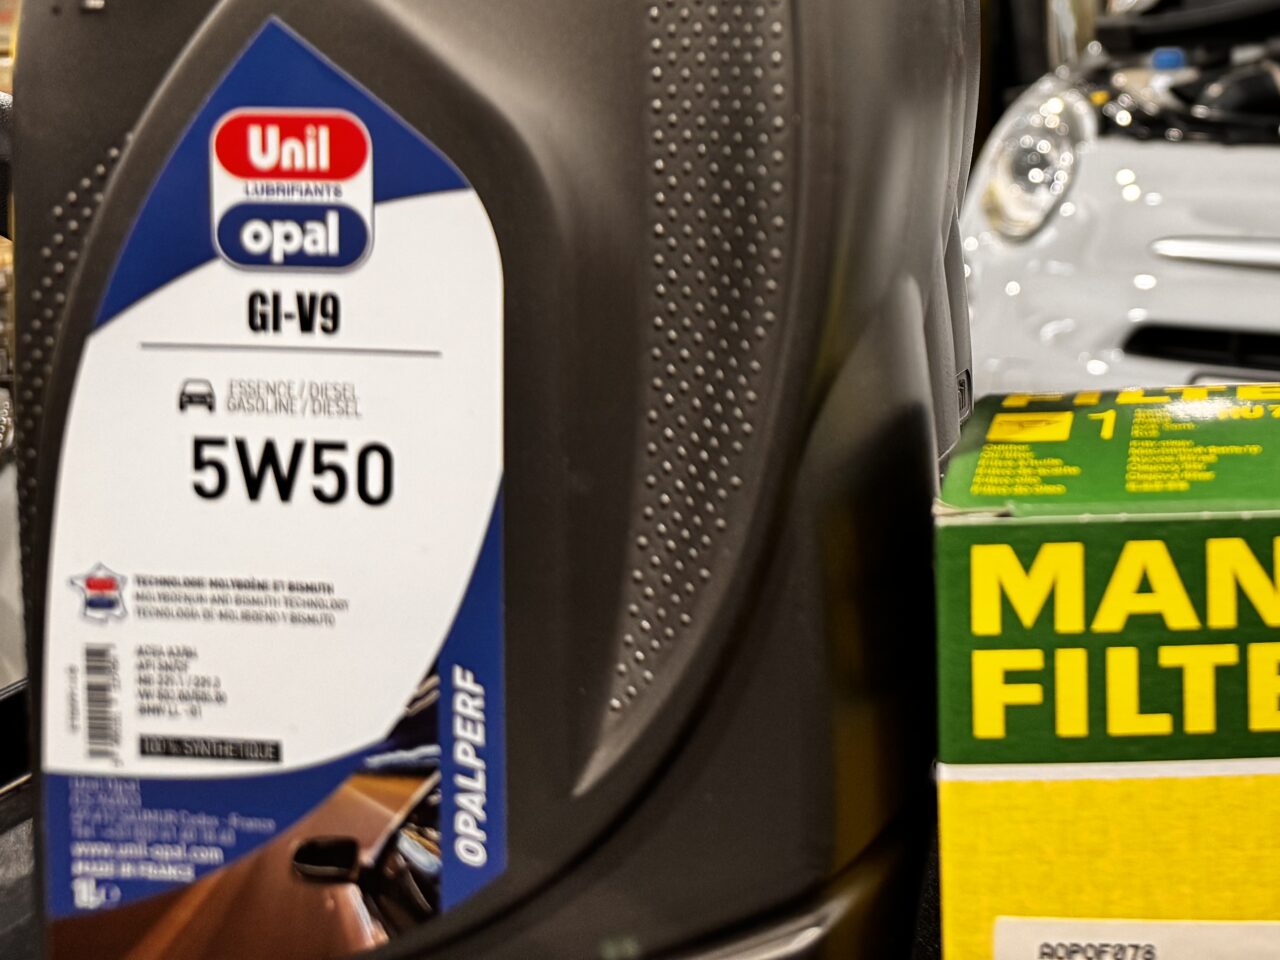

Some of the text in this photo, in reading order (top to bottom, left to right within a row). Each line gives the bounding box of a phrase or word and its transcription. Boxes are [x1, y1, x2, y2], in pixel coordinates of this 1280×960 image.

[247, 125, 330, 172] Unil
[244, 183, 343, 198] LUBRIFIANTS
[241, 209, 340, 264] opal
[247, 291, 340, 335] GI-V9
[227, 396, 298, 415] GASOLINE
[311, 398, 362, 417] DIESEL
[229, 379, 295, 397] ESSENCE
[309, 381, 359, 400] DIESEL
[192, 436, 394, 506] 5W50
[452, 663, 487, 868] OPALPERF
